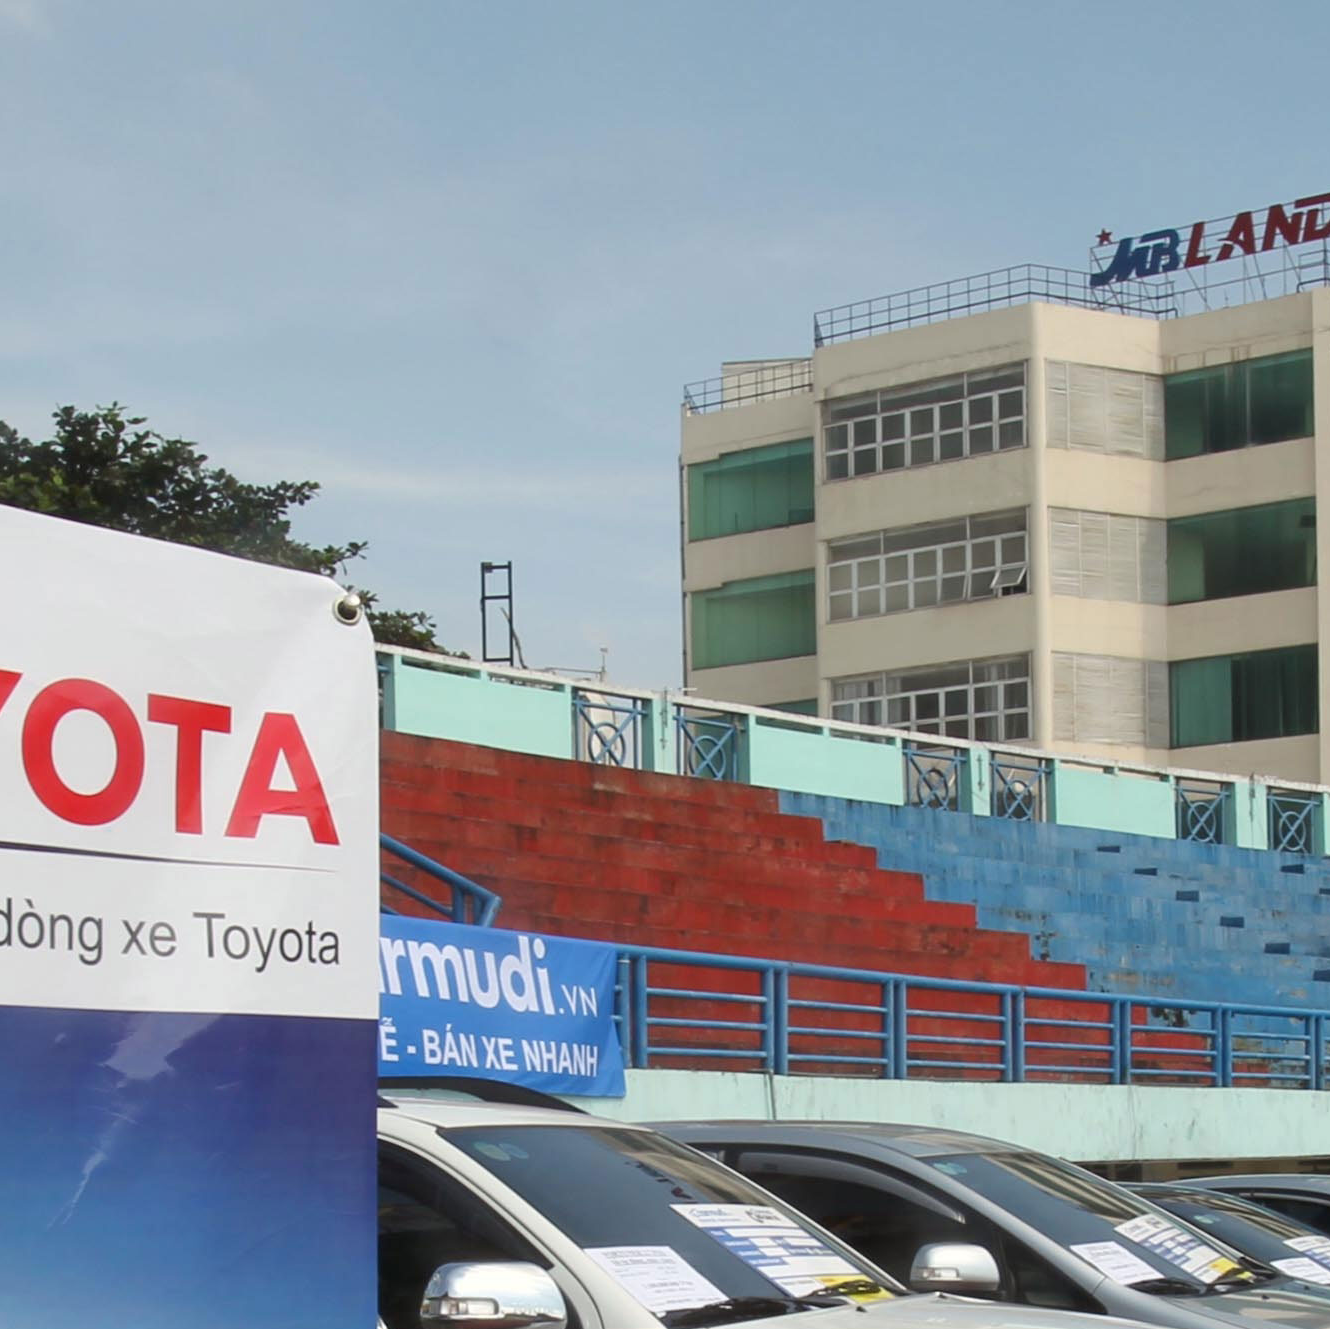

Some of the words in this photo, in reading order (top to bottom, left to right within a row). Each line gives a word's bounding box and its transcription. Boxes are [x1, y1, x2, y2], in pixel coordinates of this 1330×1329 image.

[123, 920, 176, 958] xe
[194, 913, 340, 973] Toyota
[423, 1024, 478, 1069] BÁN
[482, 1036, 519, 1072] XE
[522, 1039, 599, 1078] NHANH
